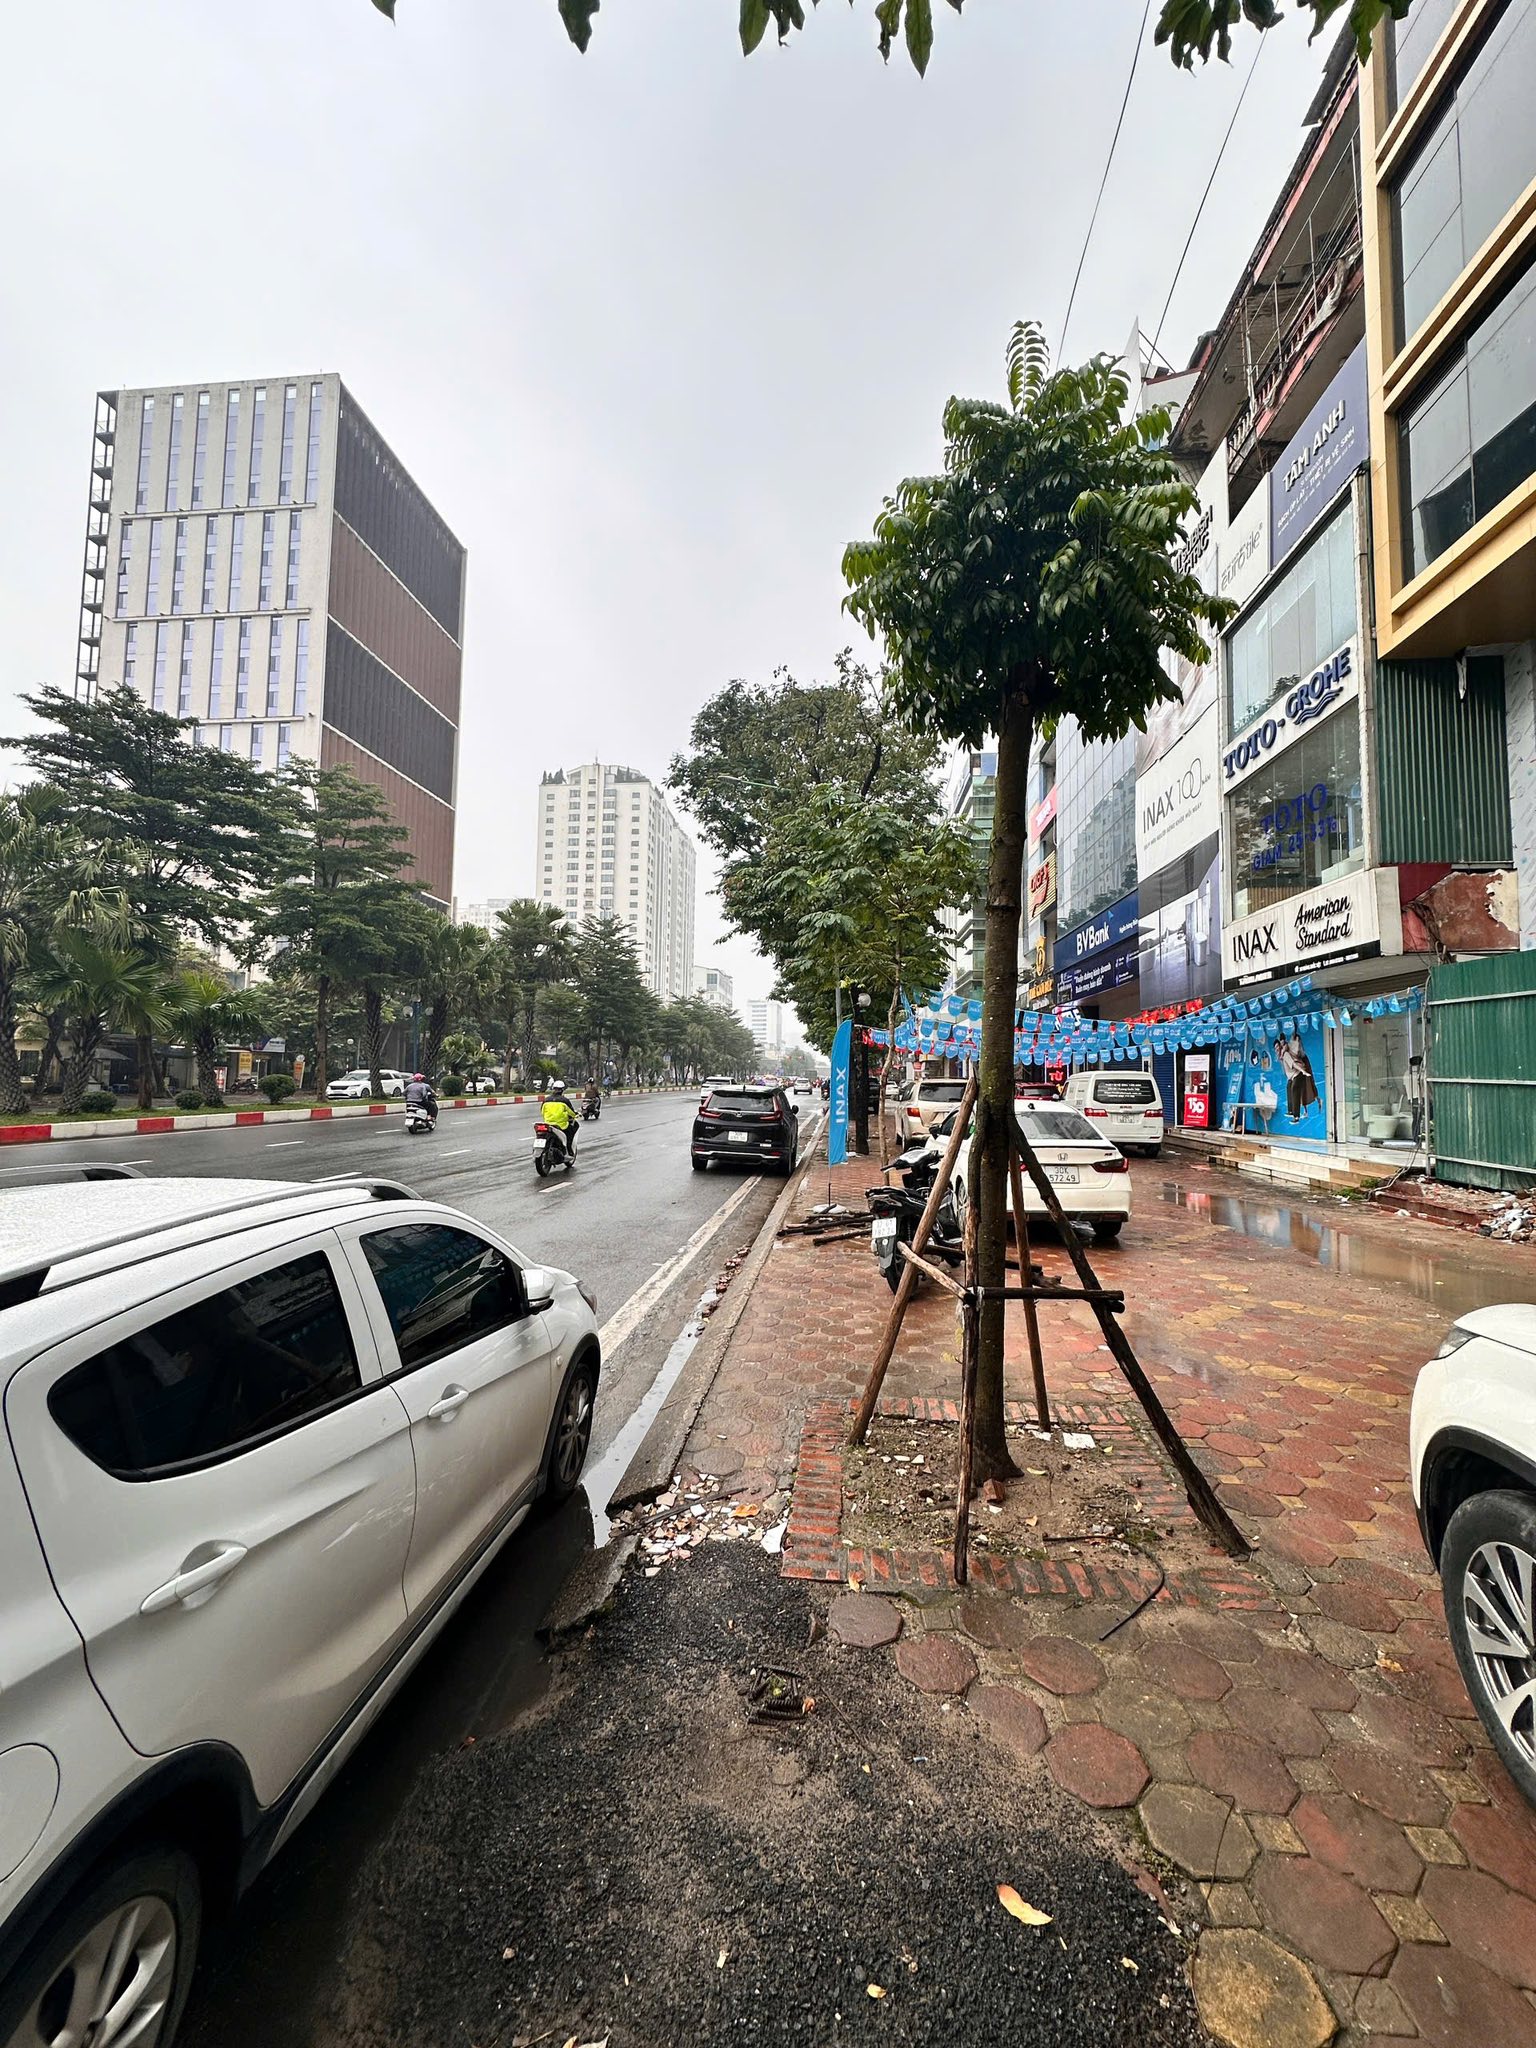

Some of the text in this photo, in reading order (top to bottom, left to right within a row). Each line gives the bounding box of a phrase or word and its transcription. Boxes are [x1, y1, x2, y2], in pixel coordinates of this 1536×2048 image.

[1312, 399, 1346, 457] ANH
[1223, 719, 1277, 779] TOTO
[1285, 646, 1352, 719] GROHE
[1143, 785, 1174, 834] INAX
[1260, 783, 1328, 834] TOTO
[1294, 896, 1350, 928] American
[1296, 912, 1350, 951] Standard
[1076, 921, 1110, 956] BVBank
[1233, 922, 1279, 963] INAX
[835, 1066, 846, 1123] INAX
